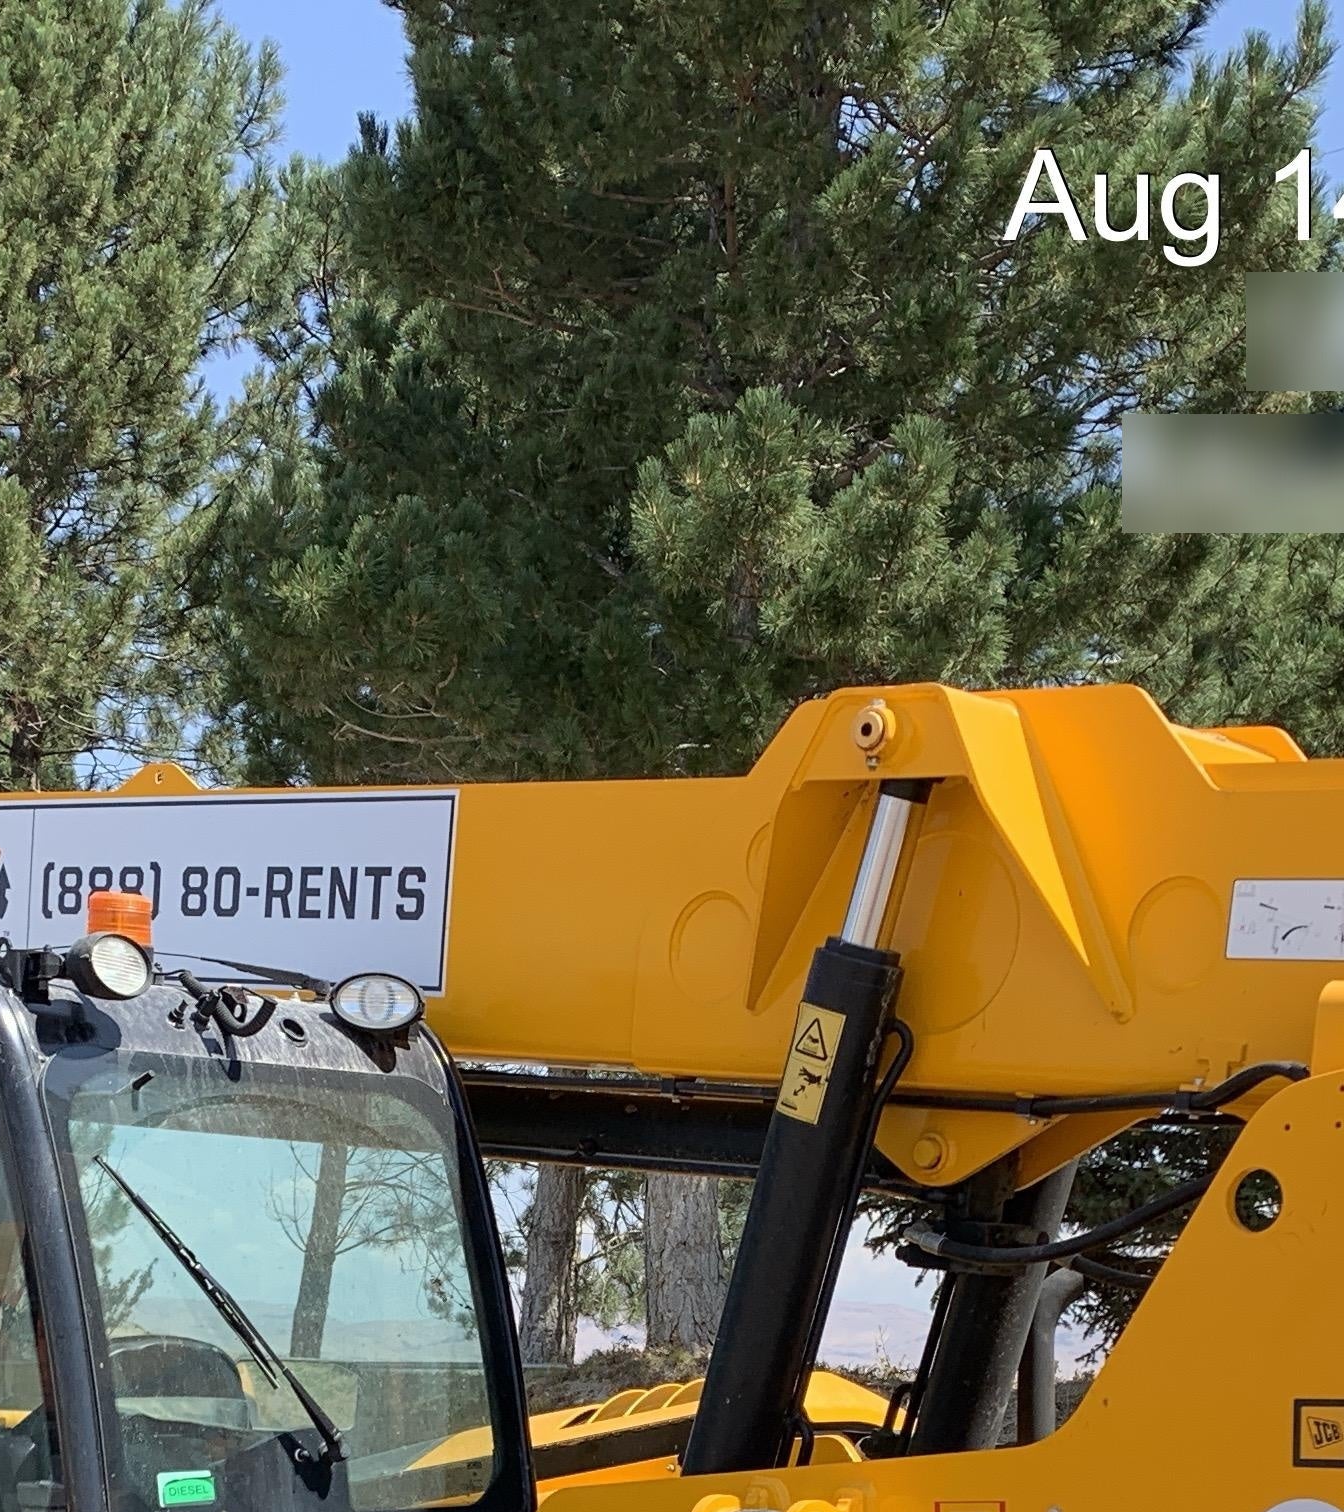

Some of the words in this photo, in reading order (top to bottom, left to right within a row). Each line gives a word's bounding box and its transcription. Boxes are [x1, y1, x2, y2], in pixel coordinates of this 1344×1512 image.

[180, 865, 427, 921] 80-RENTS
[1312, 1420, 1341, 1446] JCB
[167, 1485, 209, 1497] DIESEL
